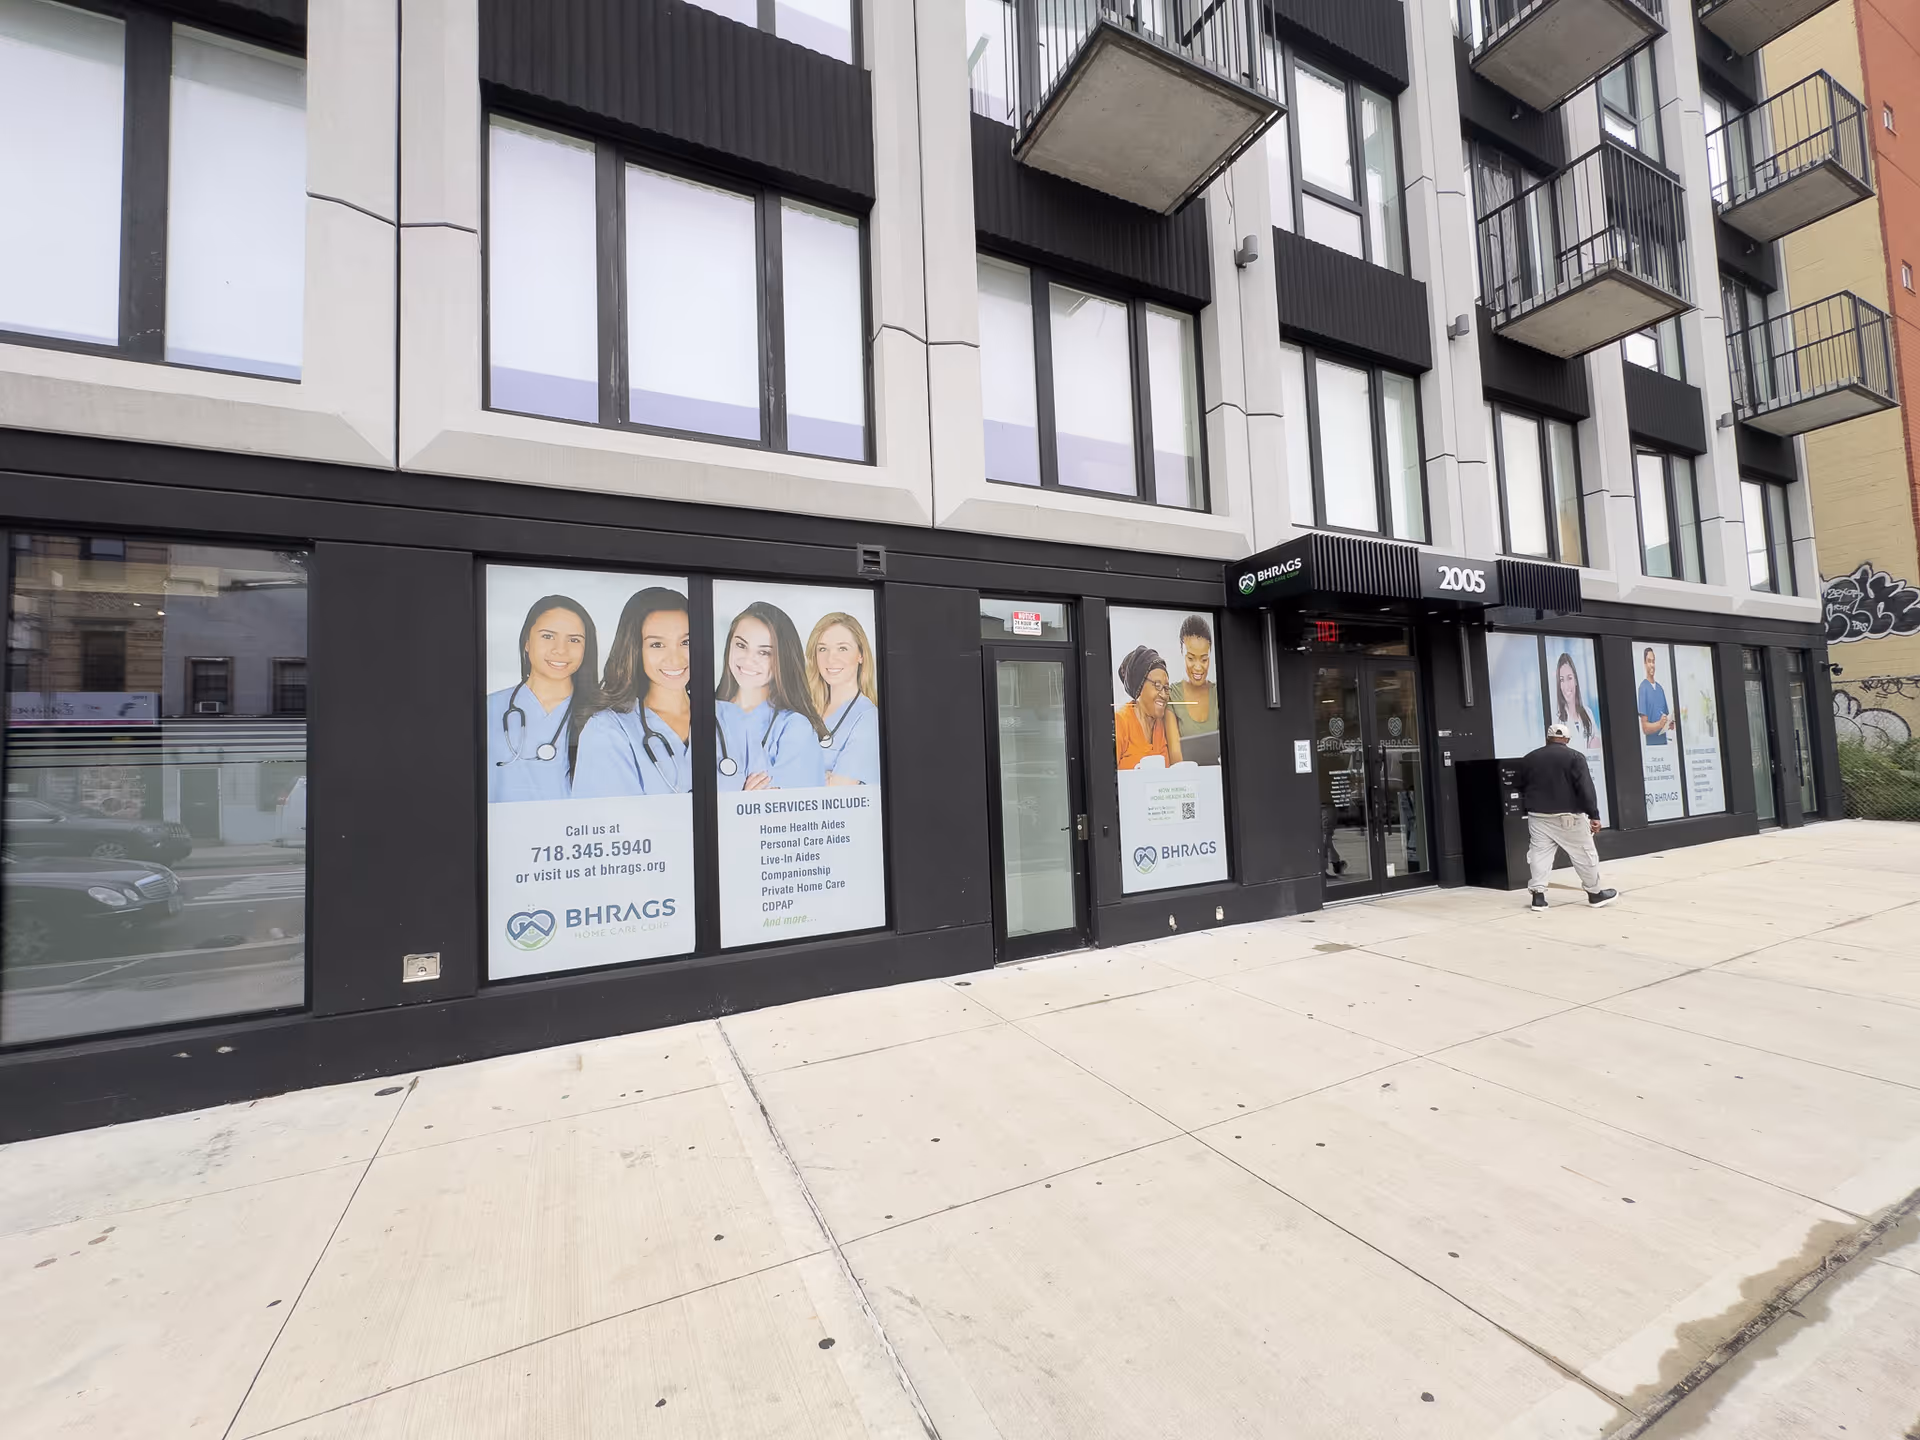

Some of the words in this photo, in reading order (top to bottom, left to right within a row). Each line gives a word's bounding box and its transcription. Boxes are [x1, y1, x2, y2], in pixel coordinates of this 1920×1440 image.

[1257, 558, 1302, 582] BHRAGS
[1438, 565, 1486, 593] 2005
[736, 803, 761, 816] OUR
[764, 800, 819, 814] SERVICES
[821, 796, 870, 810] INCLUDE:
[565, 825, 589, 837] Call
[592, 825, 606, 835] us
[609, 823, 620, 834] at
[760, 824, 787, 834] Home
[789, 821, 819, 832] Health
[821, 820, 846, 831] Aides
[531, 838, 652, 863] 718.345.5940
[760, 838, 801, 850] Personal
[803, 836, 824, 847] Care
[826, 834, 851, 845] Aides
[1161, 841, 1217, 859] BHRAGS
[760, 853, 793, 866] Live-In
[795, 851, 821, 863] Aides
[515, 873, 530, 884] or
[534, 868, 562, 882] visit
[565, 868, 580, 879] us
[584, 865, 597, 877] at
[600, 860, 666, 876] bhrags.org
[761, 865, 831, 881] Companionship
[761, 885, 794, 897] Private
[796, 882, 823, 893] Home
[825, 879, 846, 890] Care
[566, 898, 676, 928] BHRAGS
[762, 899, 794, 912] CDPAP
[763, 916, 781, 928] And
[783, 914, 817, 925] more...
[574, 929, 606, 939] HOME
[609, 926, 637, 936] CARE
